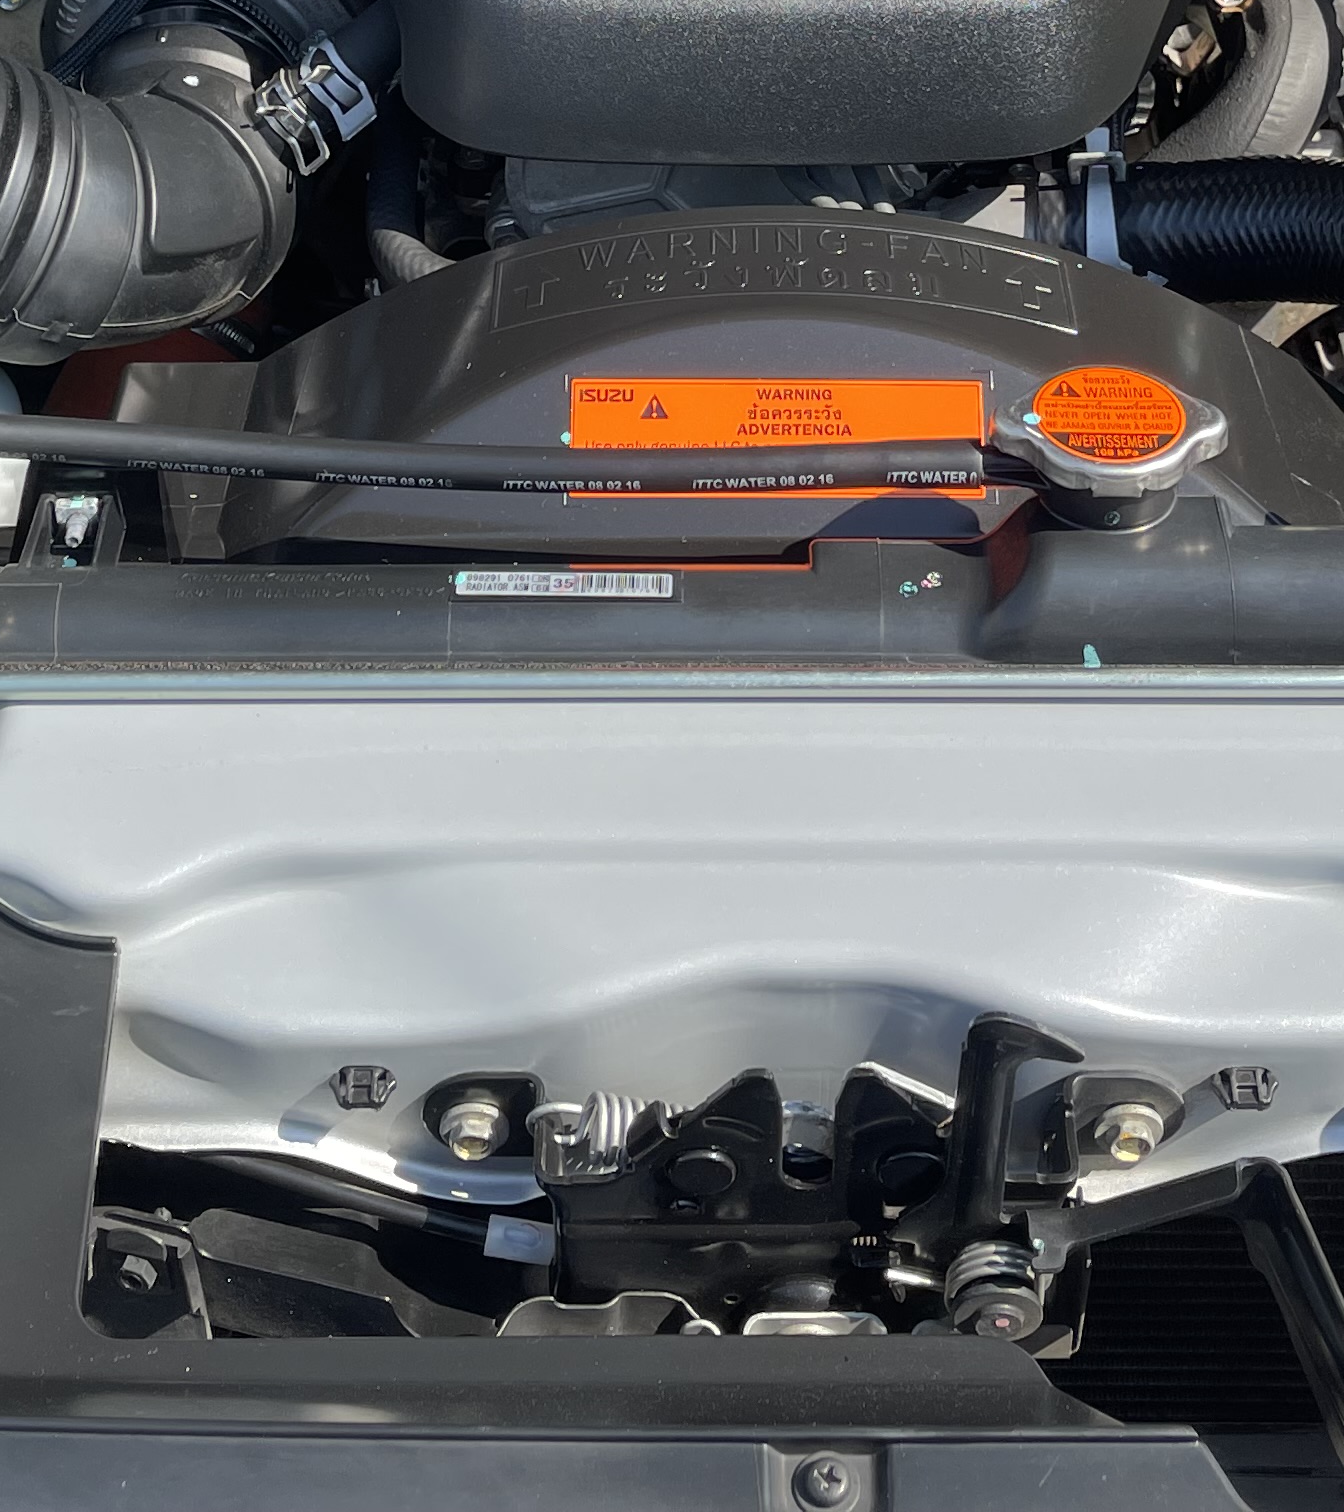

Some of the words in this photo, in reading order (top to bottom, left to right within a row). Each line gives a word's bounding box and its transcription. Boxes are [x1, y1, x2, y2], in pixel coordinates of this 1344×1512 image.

[579, 389, 635, 402] ISUZU
[756, 388, 833, 402] WARNING
[1083, 386, 1153, 399] WARNING
[747, 402, 843, 421] ข้อควรระวัง
[1044, 410, 1079, 420] NEVER
[1082, 411, 1111, 420] OPEN
[1115, 412, 1147, 420] WHEN
[1151, 412, 1172, 420] HOT
[736, 423, 853, 437] ADVERTENCIA
[1060, 422, 1096, 431] JAMAIS
[1068, 433, 1160, 449] AVERTISSEMENT
[127, 459, 158, 470] ITTC
[159, 461, 210, 474] WATER
[212, 464, 230, 476] 08
[230, 465, 247, 477] 02
[249, 467, 266, 478] 16
[315, 471, 348, 484] ITTC
[348, 474, 397, 486] WATER
[399, 476, 416, 488] 08
[418, 476, 435, 488] 02
[692, 478, 723, 490] ITTC
[725, 476, 777, 488] WATER
[779, 475, 796, 487] 08
[797, 474, 815, 486] 02
[817, 473, 835, 485] 16
[886, 471, 918, 484] ITTC
[919, 470, 968, 485] WATER
[503, 480, 533, 491] ITTC
[533, 480, 586, 492] WATER
[587, 480, 604, 491] 08
[605, 480, 623, 491] 02
[624, 480, 641, 491] 16
[507, 573, 531, 582] 0761
[552, 577, 576, 589] 35
[465, 582, 509, 591] RADIATOR
